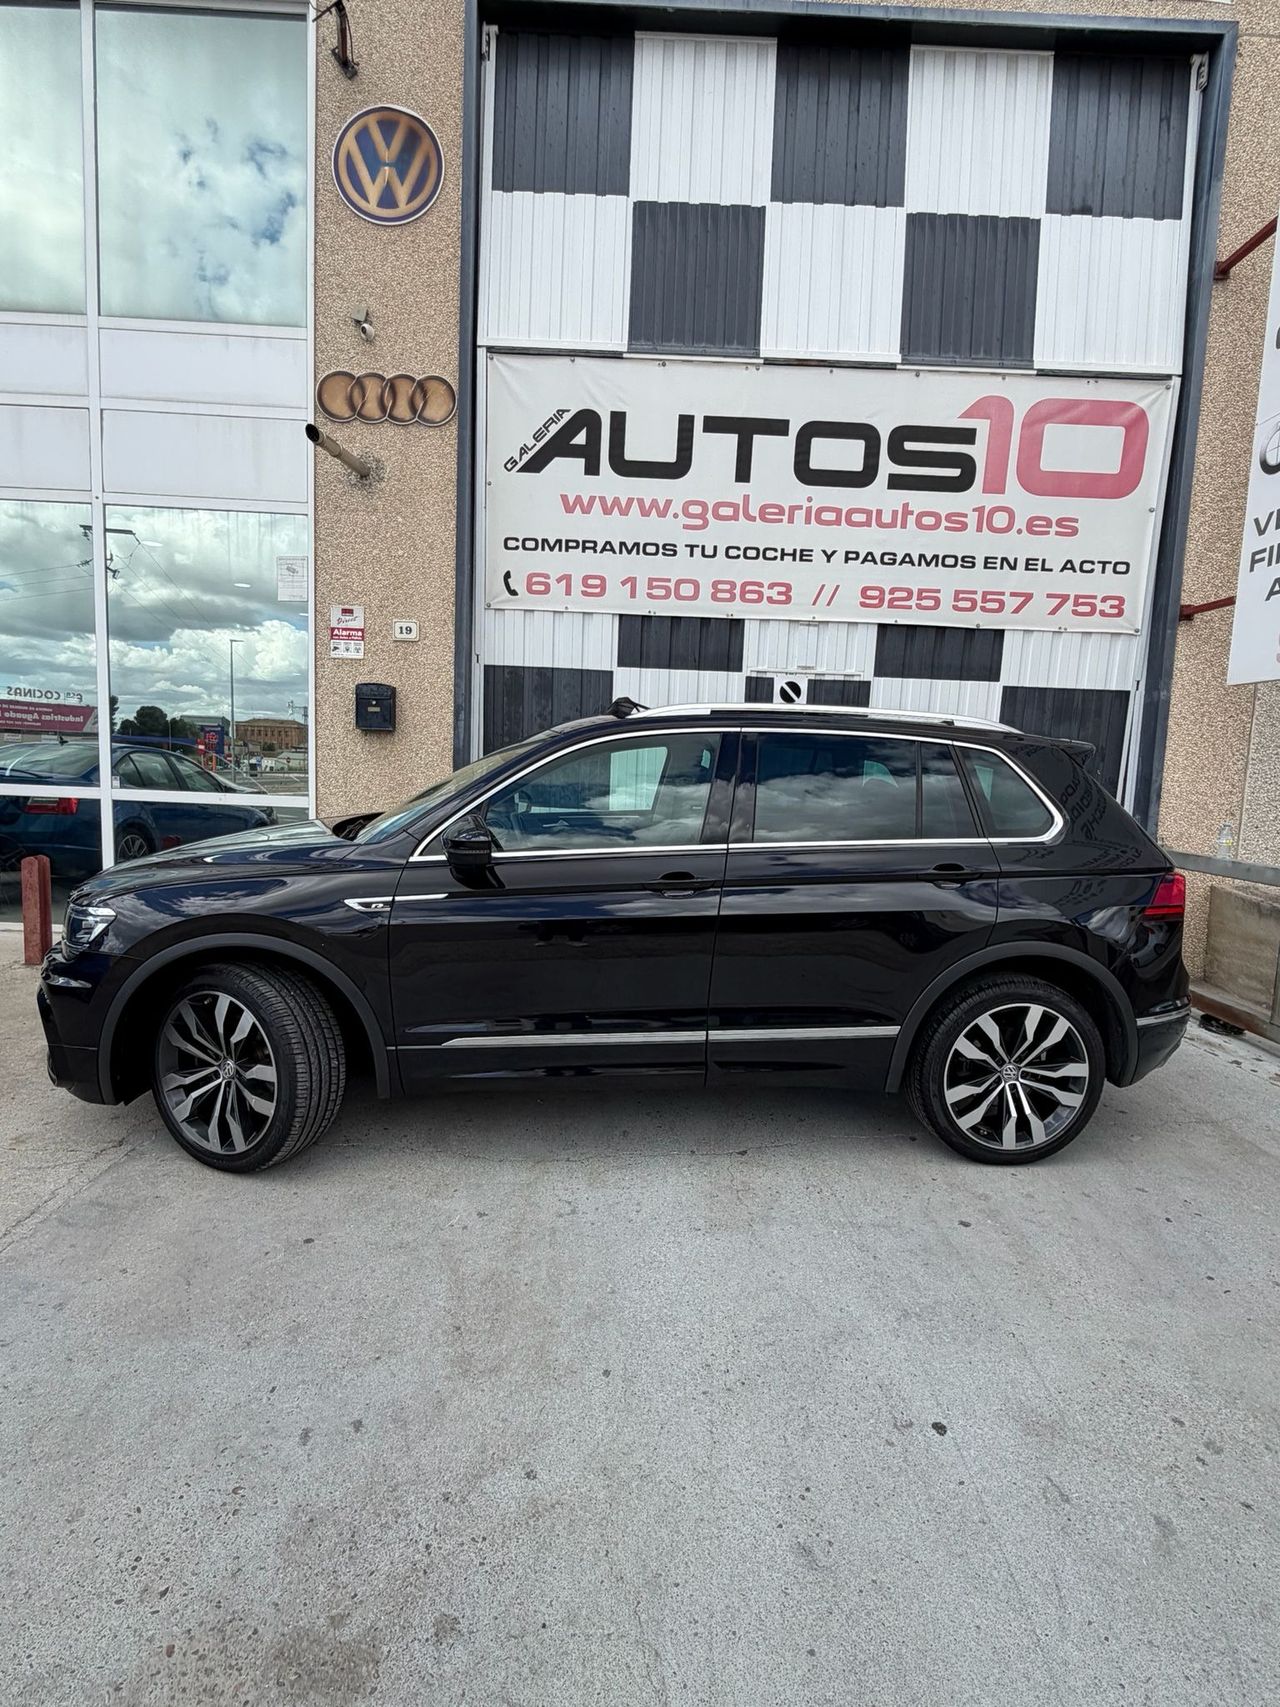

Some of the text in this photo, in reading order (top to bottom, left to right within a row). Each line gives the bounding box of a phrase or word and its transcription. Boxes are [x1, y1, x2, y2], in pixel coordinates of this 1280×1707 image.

[503, 408, 572, 472] GALERIA
[559, 493, 1080, 538] www.galeriaautos10.es
[503, 536, 1131, 575] COMPRAMOS TU COCHE Y PAGAMOS EN EL ACTO
[525, 571, 607, 598] 619
[620, 576, 701, 601] 150
[710, 579, 793, 605] 863
[858, 585, 942, 611] 925
[952, 589, 1034, 614] 557
[1045, 592, 1126, 618] 753
[332, 628, 363, 637] Alarma
[399, 626, 412, 635] 19
